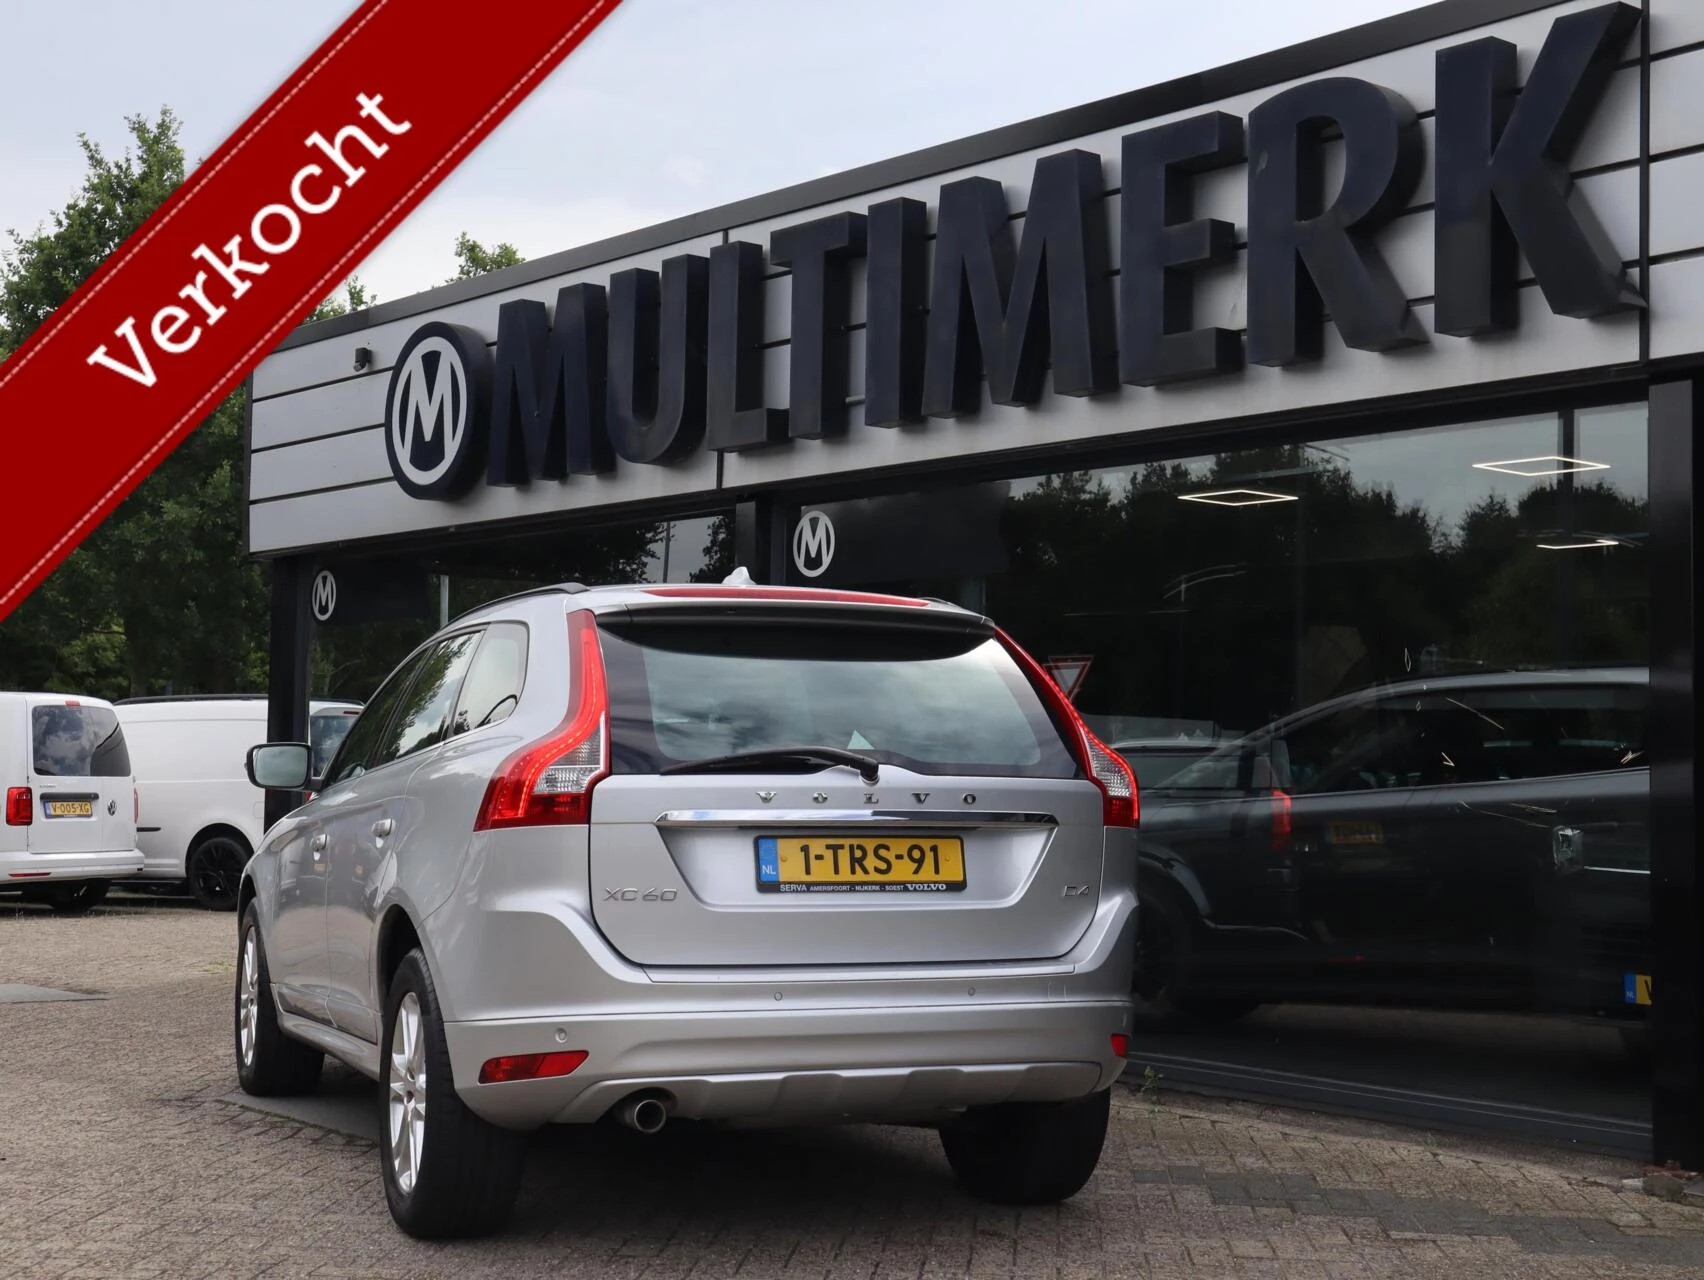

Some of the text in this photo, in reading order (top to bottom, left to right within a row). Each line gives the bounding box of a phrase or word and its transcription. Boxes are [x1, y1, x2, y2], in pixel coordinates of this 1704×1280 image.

[487, 2, 1647, 487] MULTIMERK
[756, 791, 977, 804] VOLVO
[50, 803, 89, 814] V-005-XG
[800, 843, 940, 875] 1-TRS-91
[761, 864, 777, 875] NL
[780, 883, 808, 892] SERVA
[905, 883, 947, 891] VOLVO
[1063, 885, 1089, 897] D4
